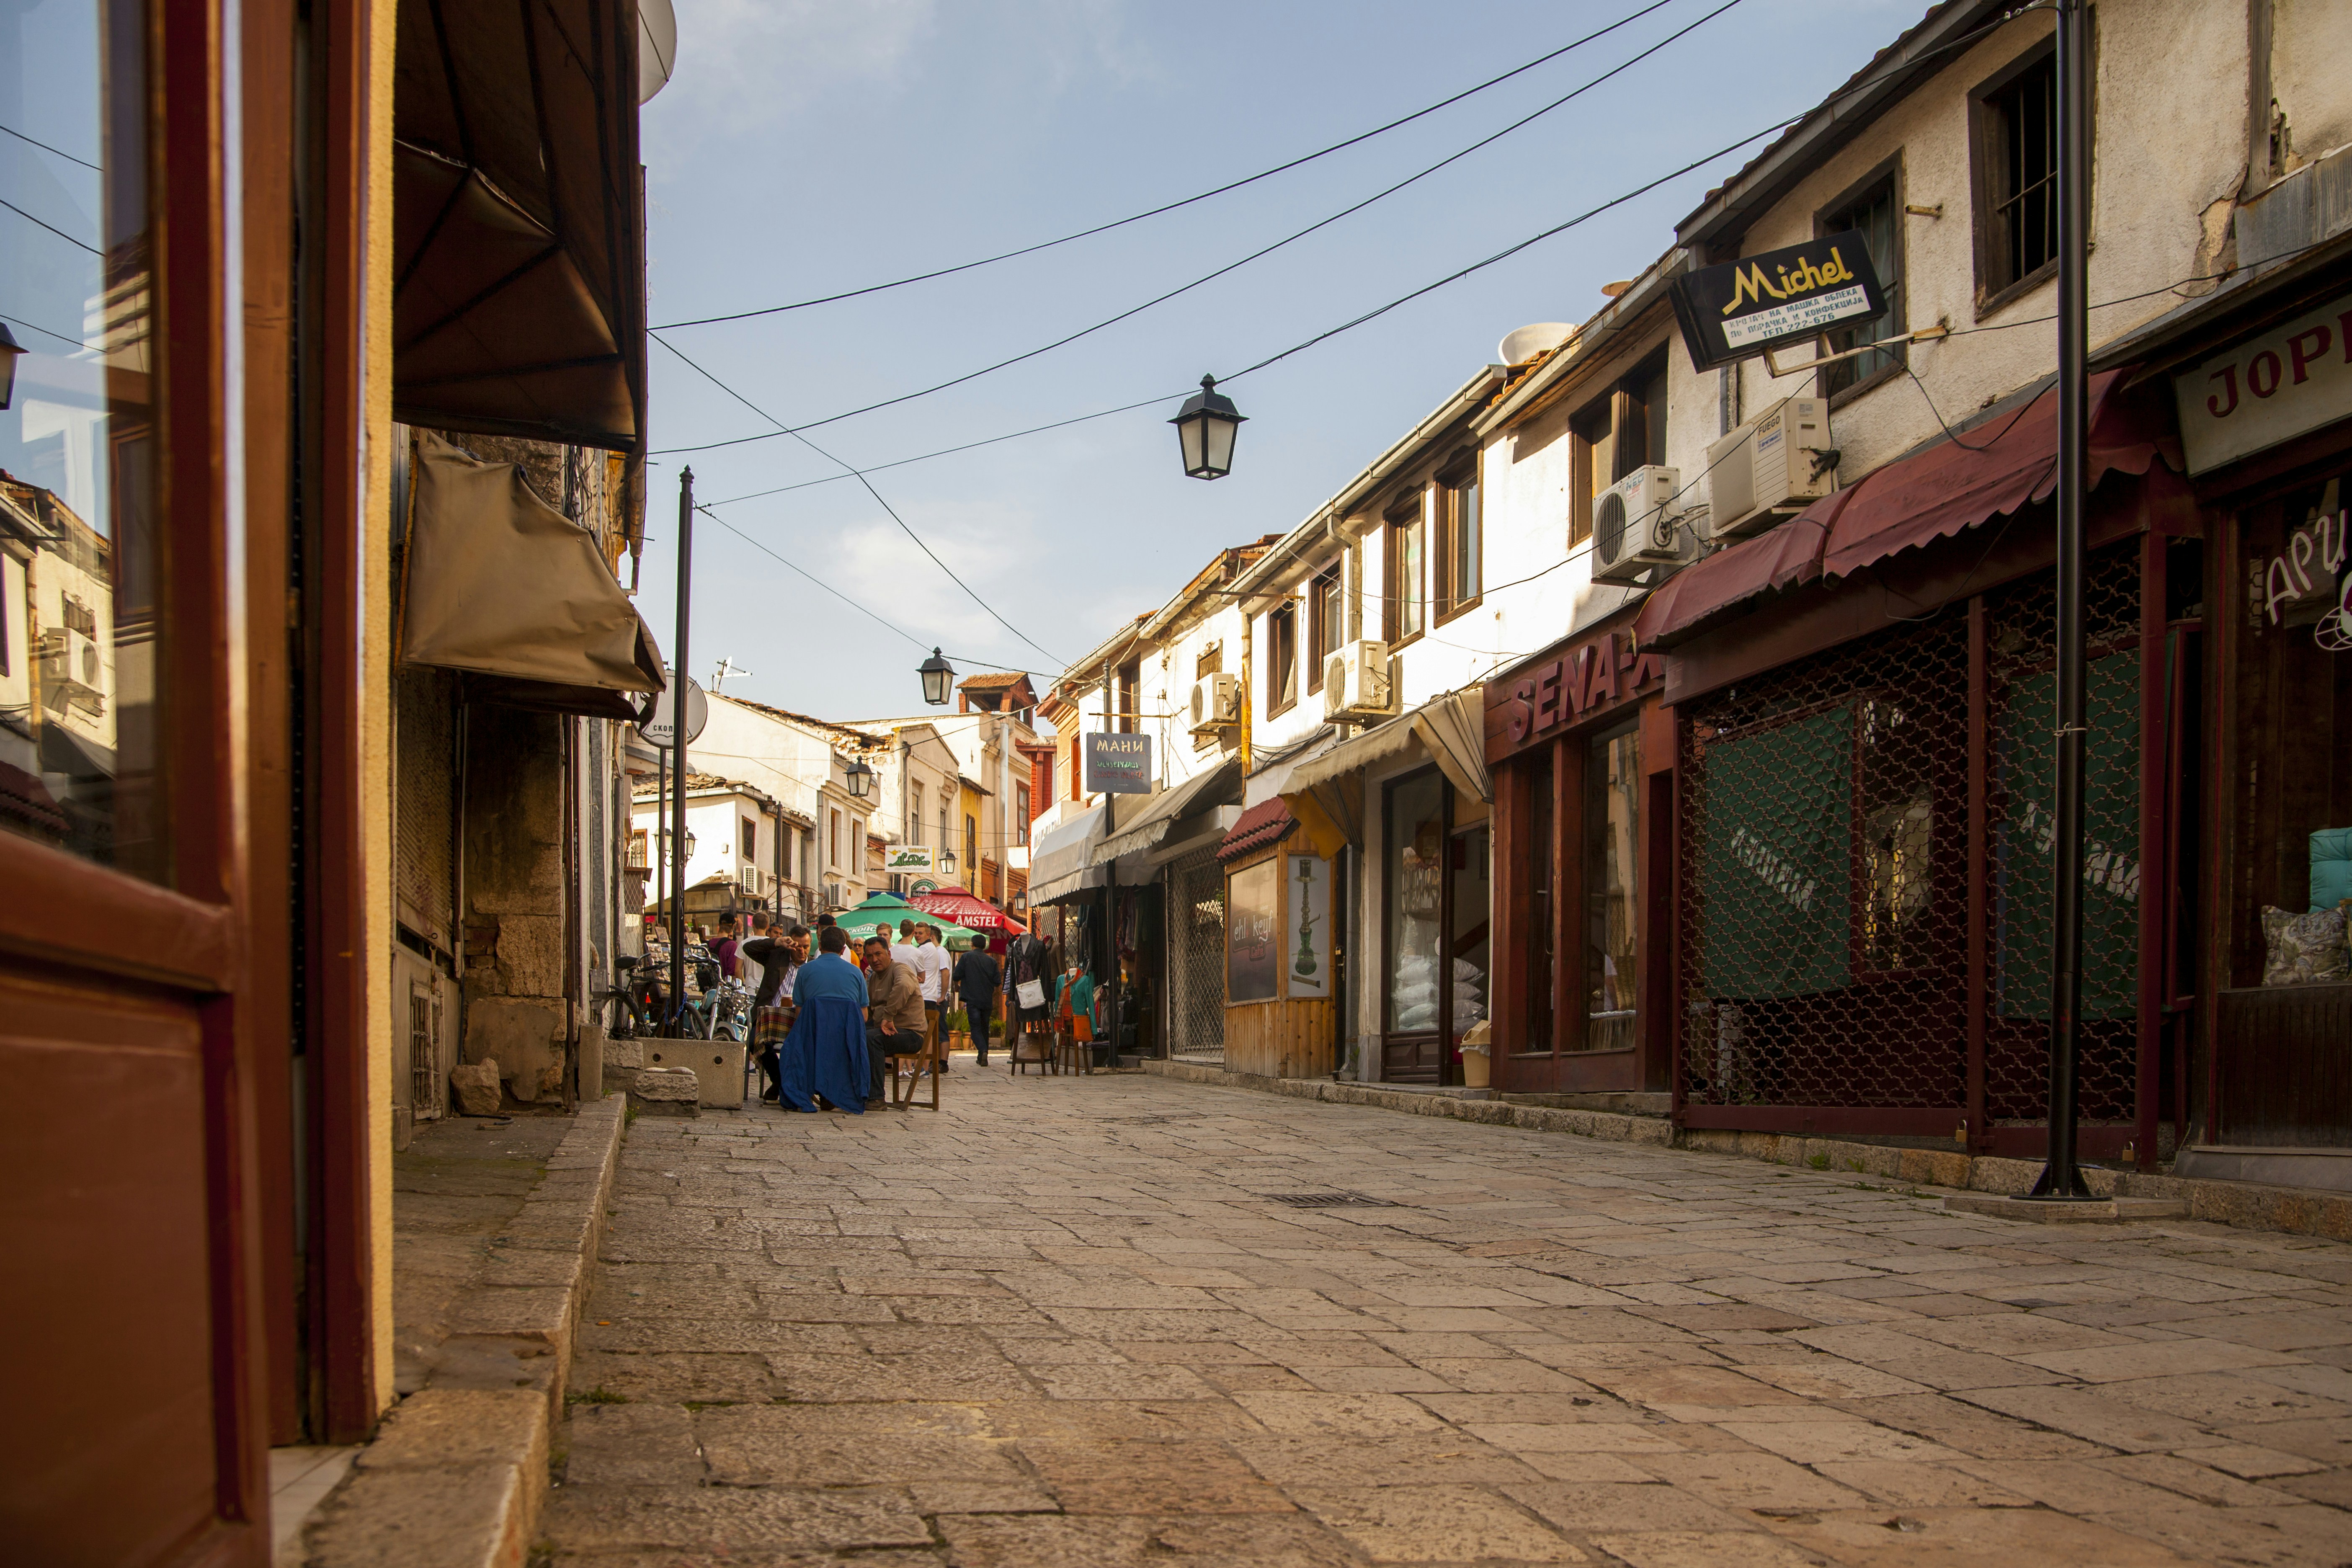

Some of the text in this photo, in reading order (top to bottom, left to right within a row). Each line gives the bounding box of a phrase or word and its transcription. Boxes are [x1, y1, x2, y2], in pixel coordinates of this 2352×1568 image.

[1722, 247, 1854, 315] Michel
[1787, 299, 1820, 313] МАШКА
[1825, 288, 1858, 302] ОБЛЕКА
[1748, 317, 1787, 333] ПОРАЧКА
[1805, 297, 1864, 317] КОНФЕКЦИЈА
[1759, 415, 1780, 436] FUEGO
[1096, 740, 1143, 753] МАНИ
[888, 852, 931, 867] Aladdin
[955, 915, 998, 927] AMSTEL
[1253, 910, 1273, 941] keyf
